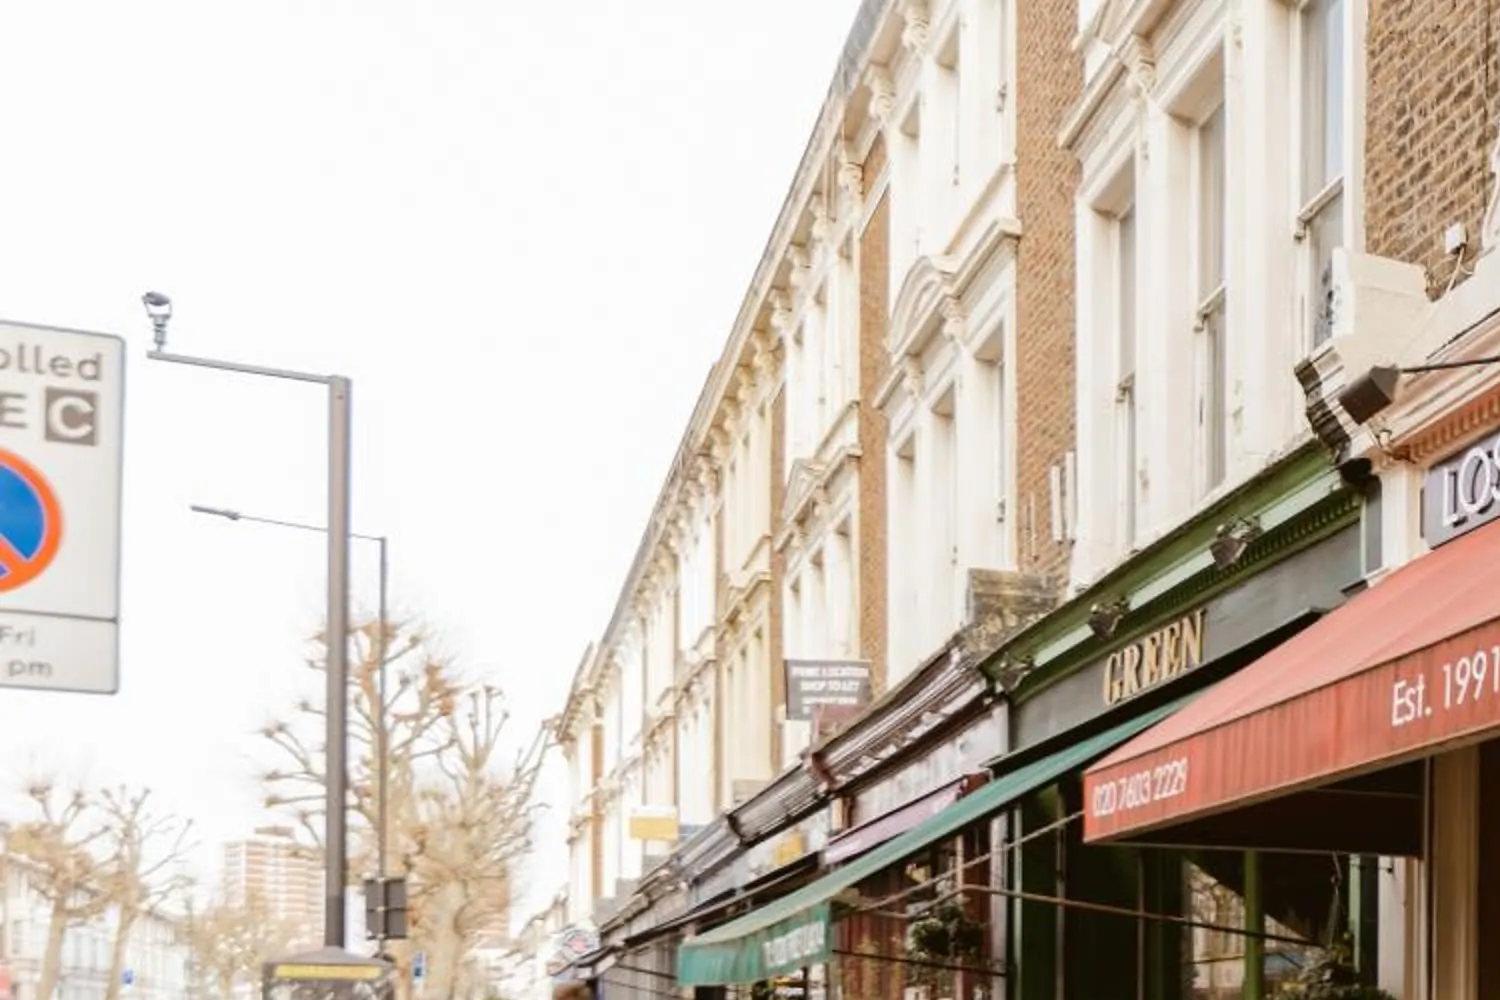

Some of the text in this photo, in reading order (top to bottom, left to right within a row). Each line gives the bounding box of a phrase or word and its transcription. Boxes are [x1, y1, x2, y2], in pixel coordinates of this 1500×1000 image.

[48, 395, 96, 439] C
[7, 658, 54, 680] pm
[1103, 608, 1206, 707] GREEN
[1391, 679, 1432, 728] Est.
[1092, 780, 1117, 817] 020
